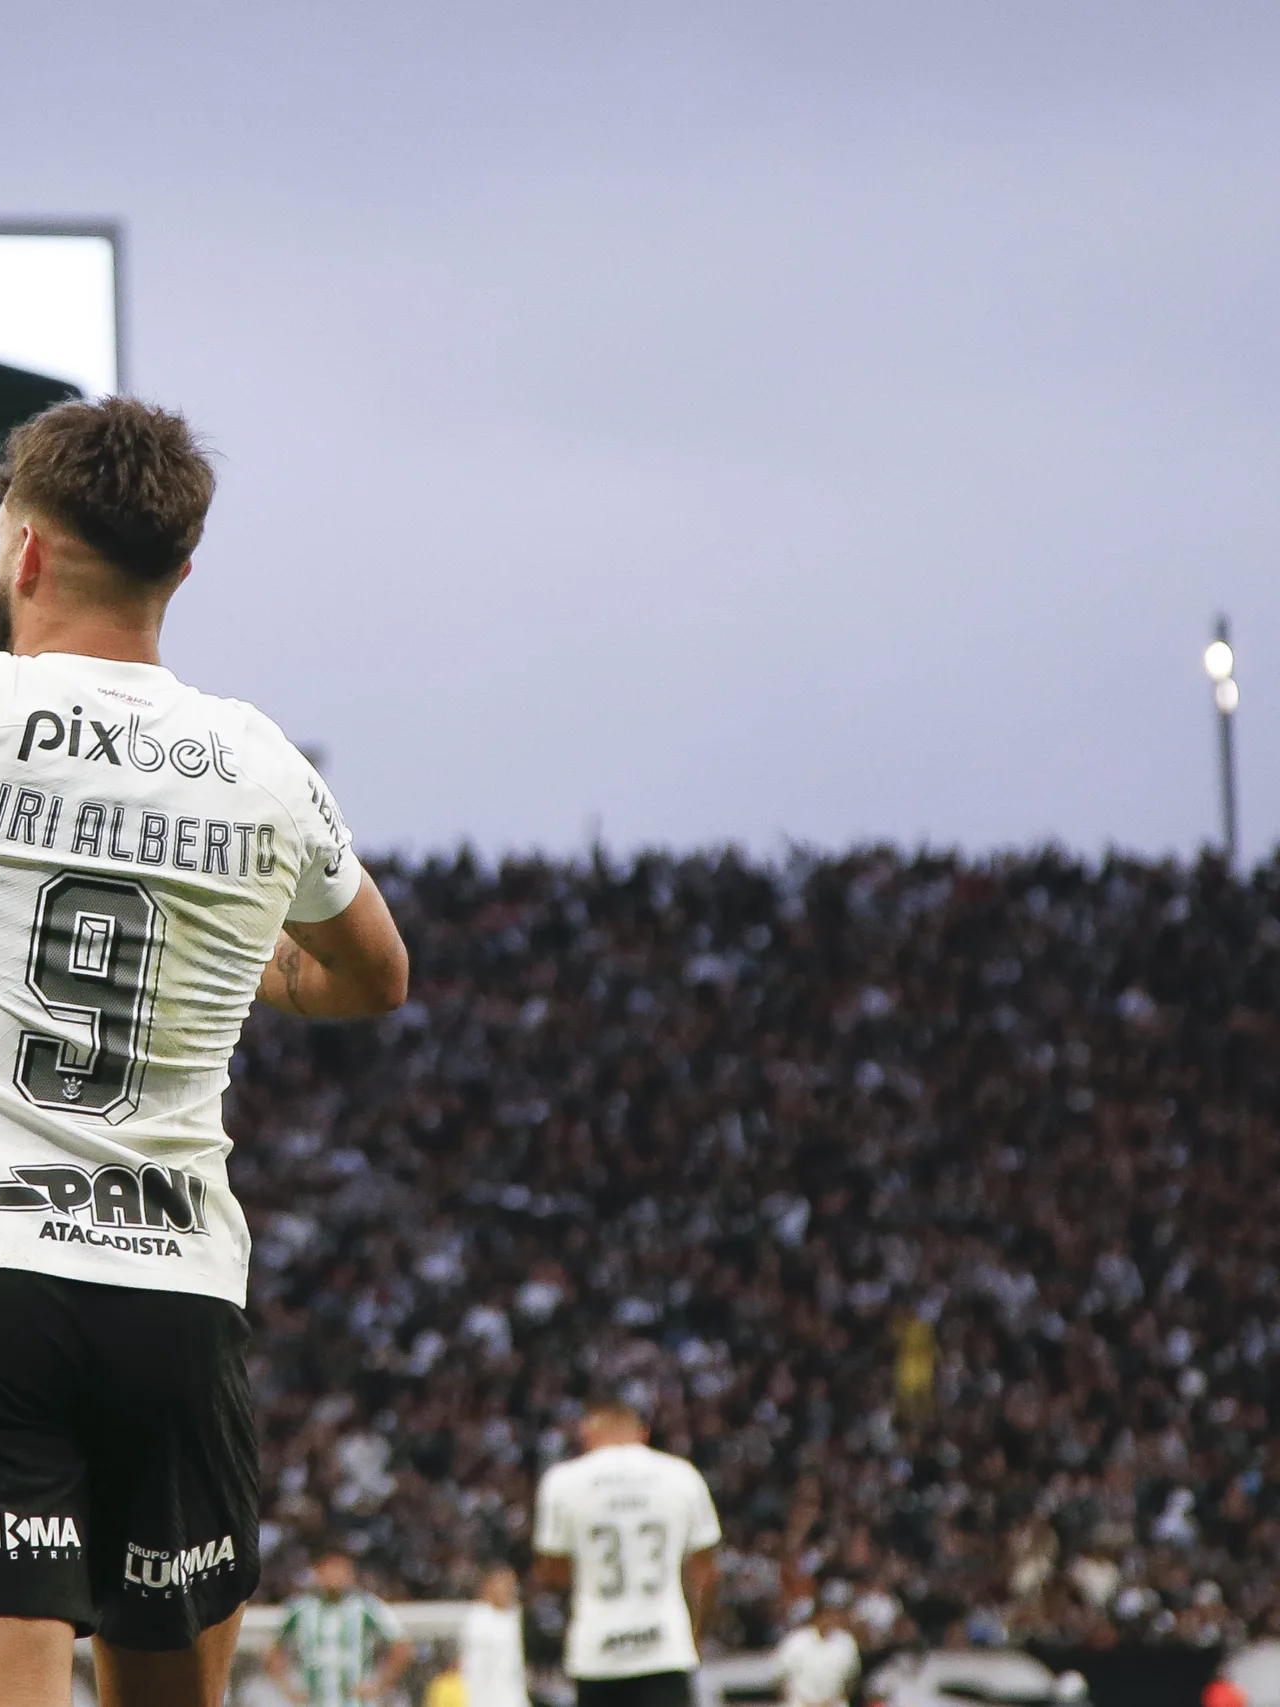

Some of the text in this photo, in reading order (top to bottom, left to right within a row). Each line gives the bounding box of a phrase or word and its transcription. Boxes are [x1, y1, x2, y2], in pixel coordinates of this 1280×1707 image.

[16, 705, 237, 784] pixbet
[70, 801, 276, 877] ALBERTO
[13, 868, 168, 1127] 9
[38, 1220, 183, 1258] ATACADISTA
[128, 1541, 170, 1561] GRUPO
[589, 1521, 667, 1600] 33
